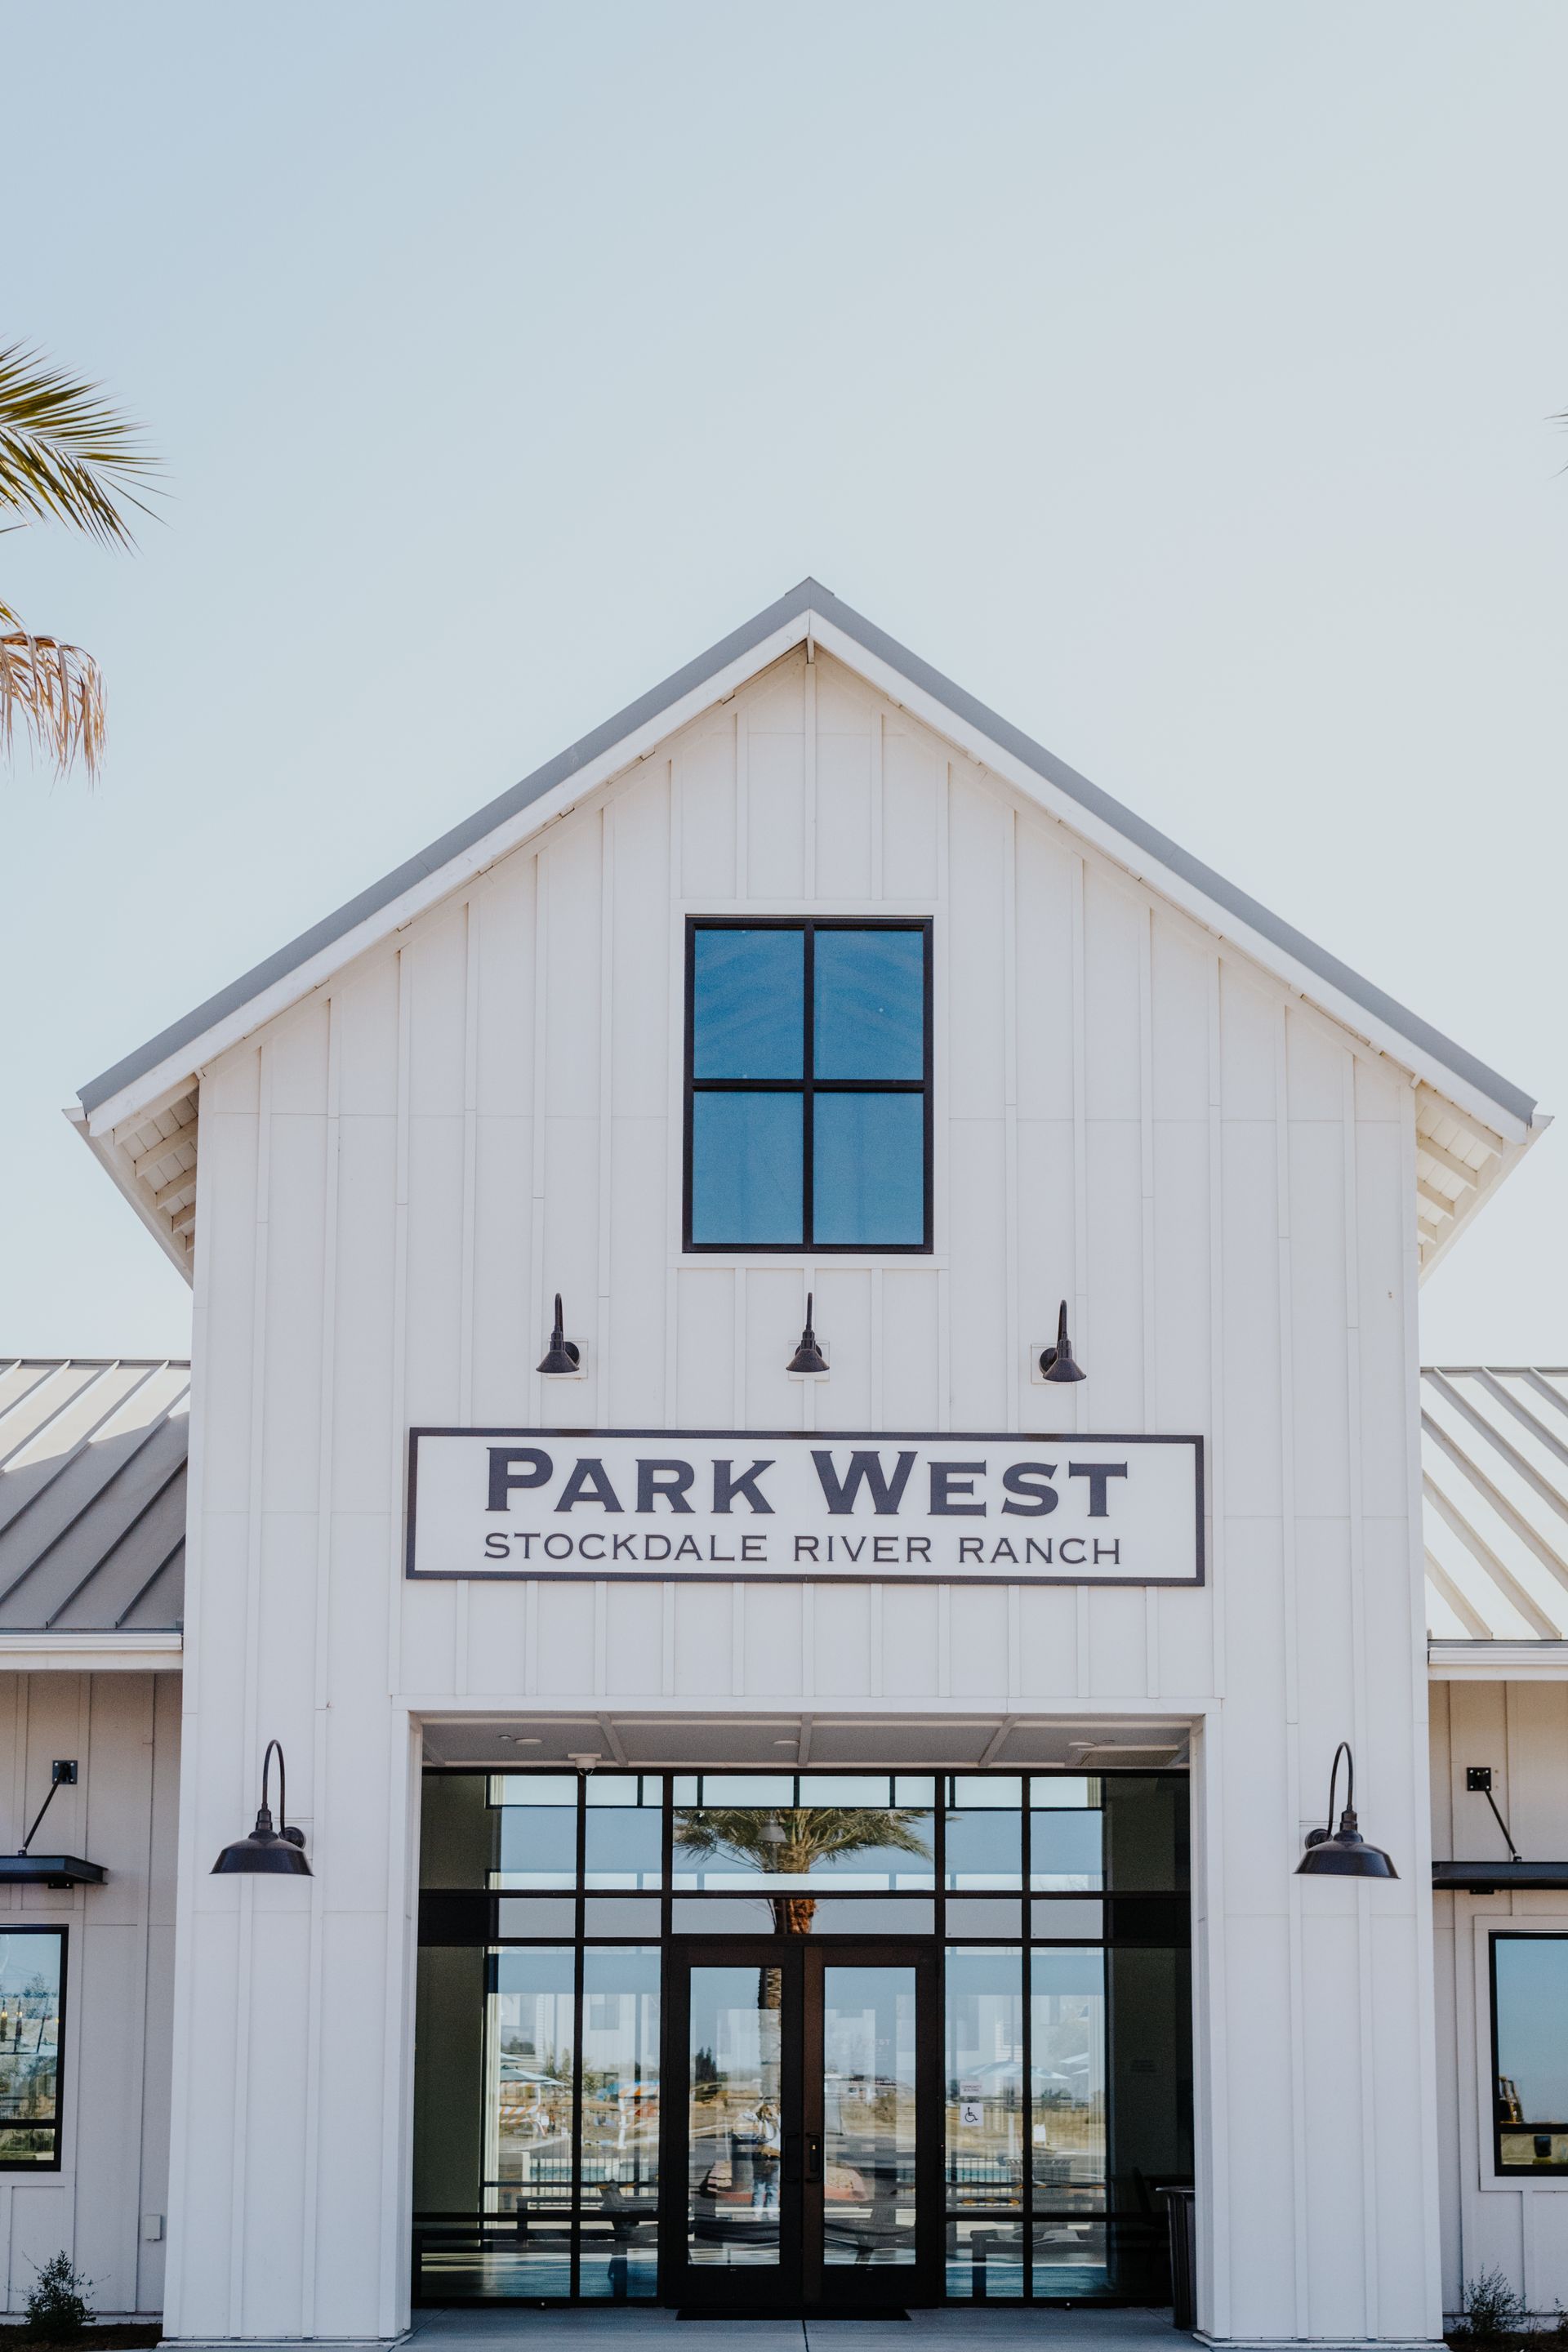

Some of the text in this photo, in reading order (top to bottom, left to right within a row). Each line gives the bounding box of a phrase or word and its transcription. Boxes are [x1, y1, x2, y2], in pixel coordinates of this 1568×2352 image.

[484, 1446, 1128, 1518] PARK WEST
[483, 1532, 1120, 1565] STOCKDALE RIVER RANCH
